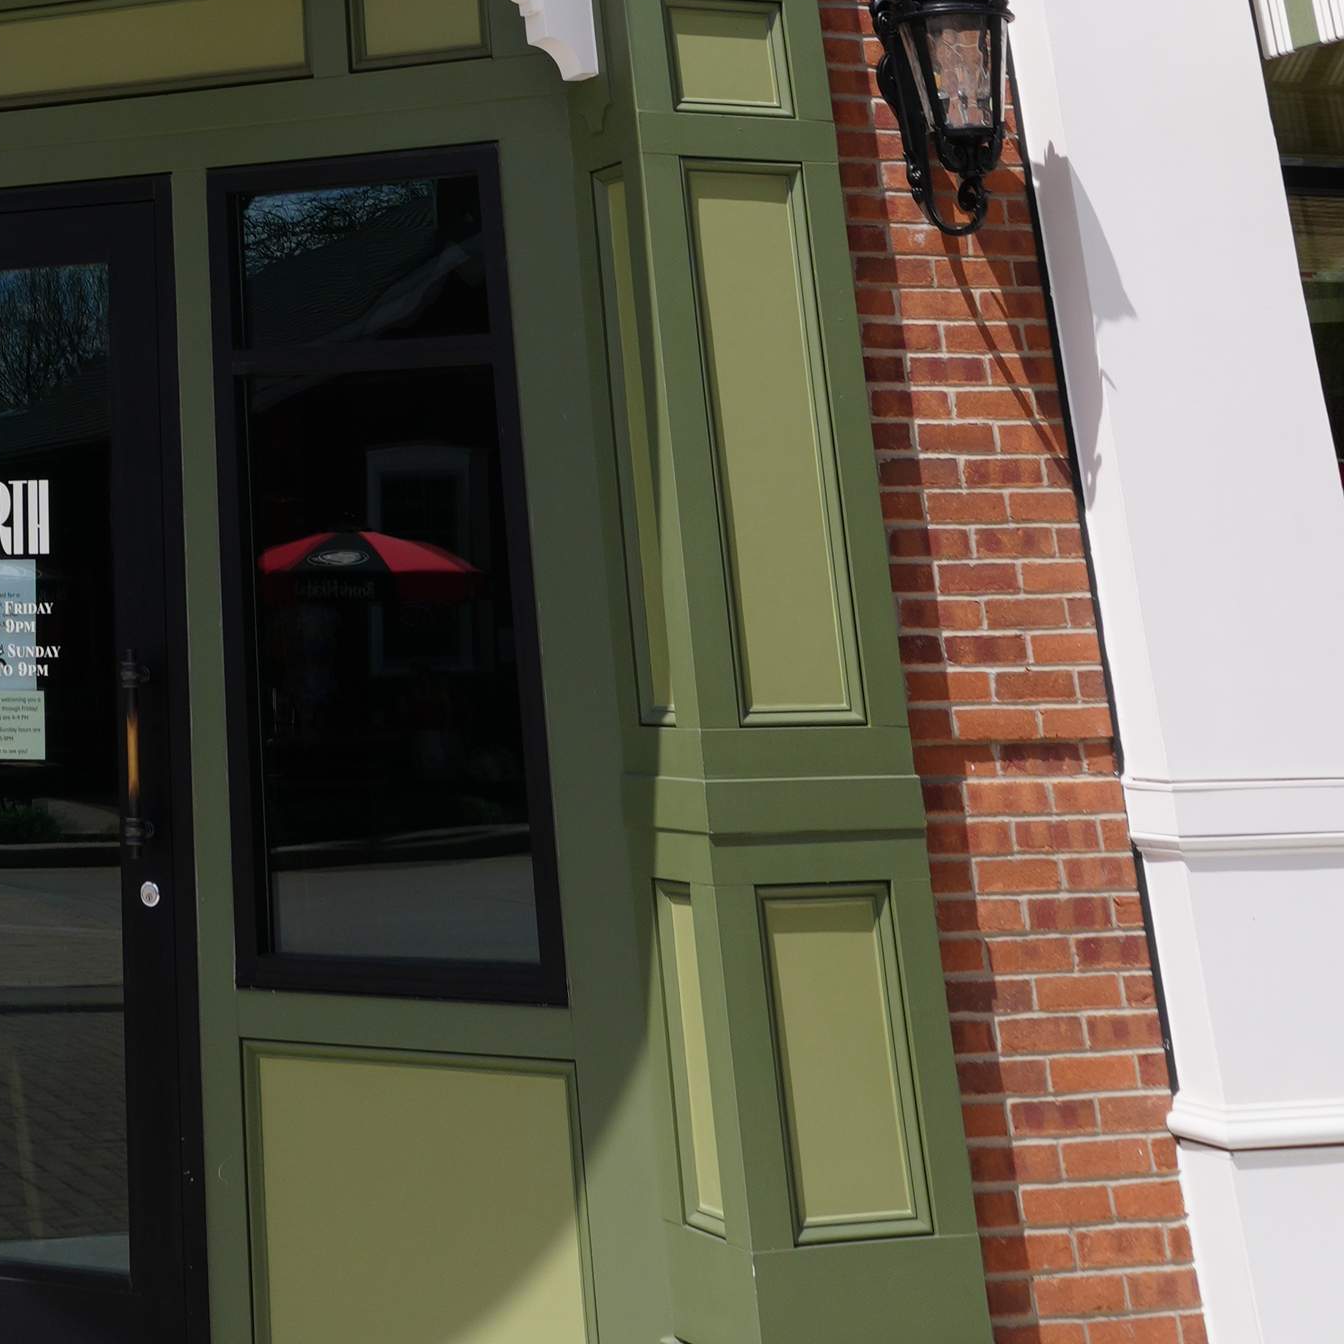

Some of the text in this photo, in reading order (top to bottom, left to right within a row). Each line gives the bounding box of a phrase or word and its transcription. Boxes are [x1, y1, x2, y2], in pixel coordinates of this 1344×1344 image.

[4, 600, 54, 615] FRIDAY
[5, 618, 36, 633] 9PM
[7, 643, 61, 658] SUNDAY
[18, 662, 49, 676] 9PM
